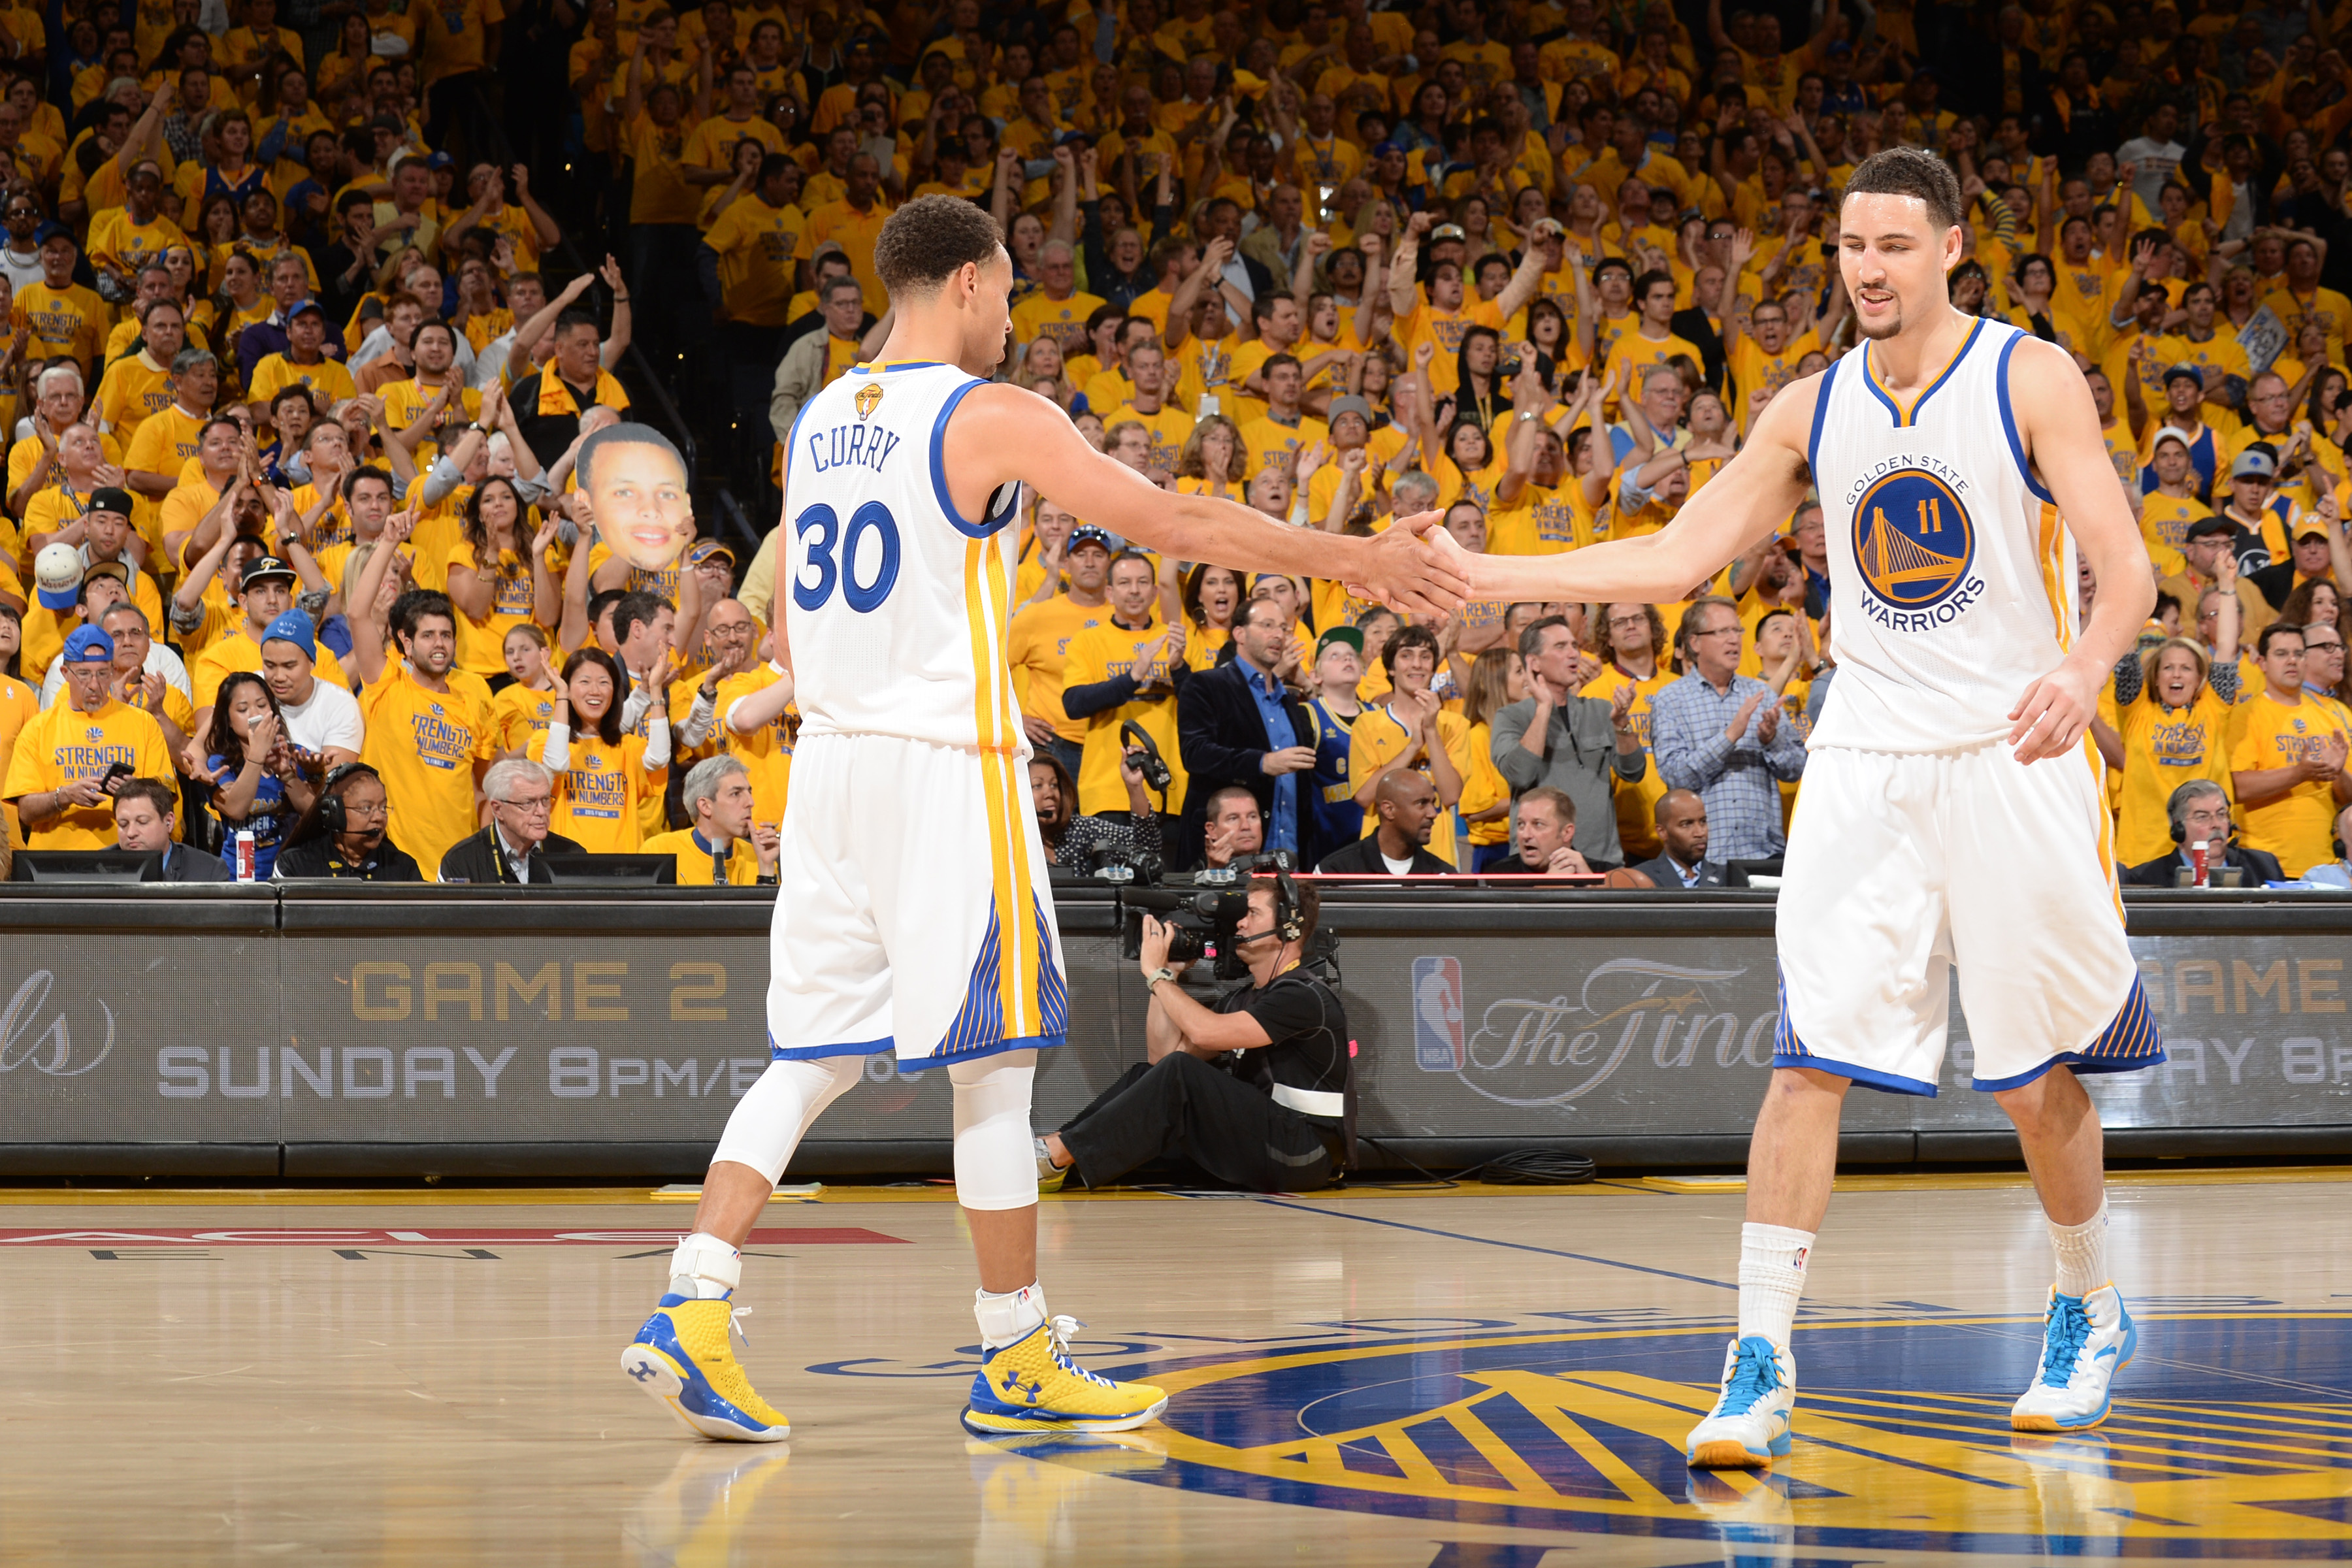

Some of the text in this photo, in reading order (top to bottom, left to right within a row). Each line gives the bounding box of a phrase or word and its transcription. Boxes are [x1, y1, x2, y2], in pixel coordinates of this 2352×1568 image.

[810, 425, 900, 473] CURRY
[1846, 454, 1969, 505] GOLDEN STATE
[1917, 498, 1942, 534] 11
[793, 500, 901, 613] 30
[1859, 575, 1985, 632] WARRIORS
[56, 746, 135, 766] STRENGTH
[64, 766, 74, 779] IN
[567, 789, 625, 806] IN NUMBERS
[1279, 851, 1290, 869] AKG
[351, 961, 727, 1021] GAME 2
[1469, 995, 1601, 1070] The
[157, 1046, 519, 1098] SUNDAY
